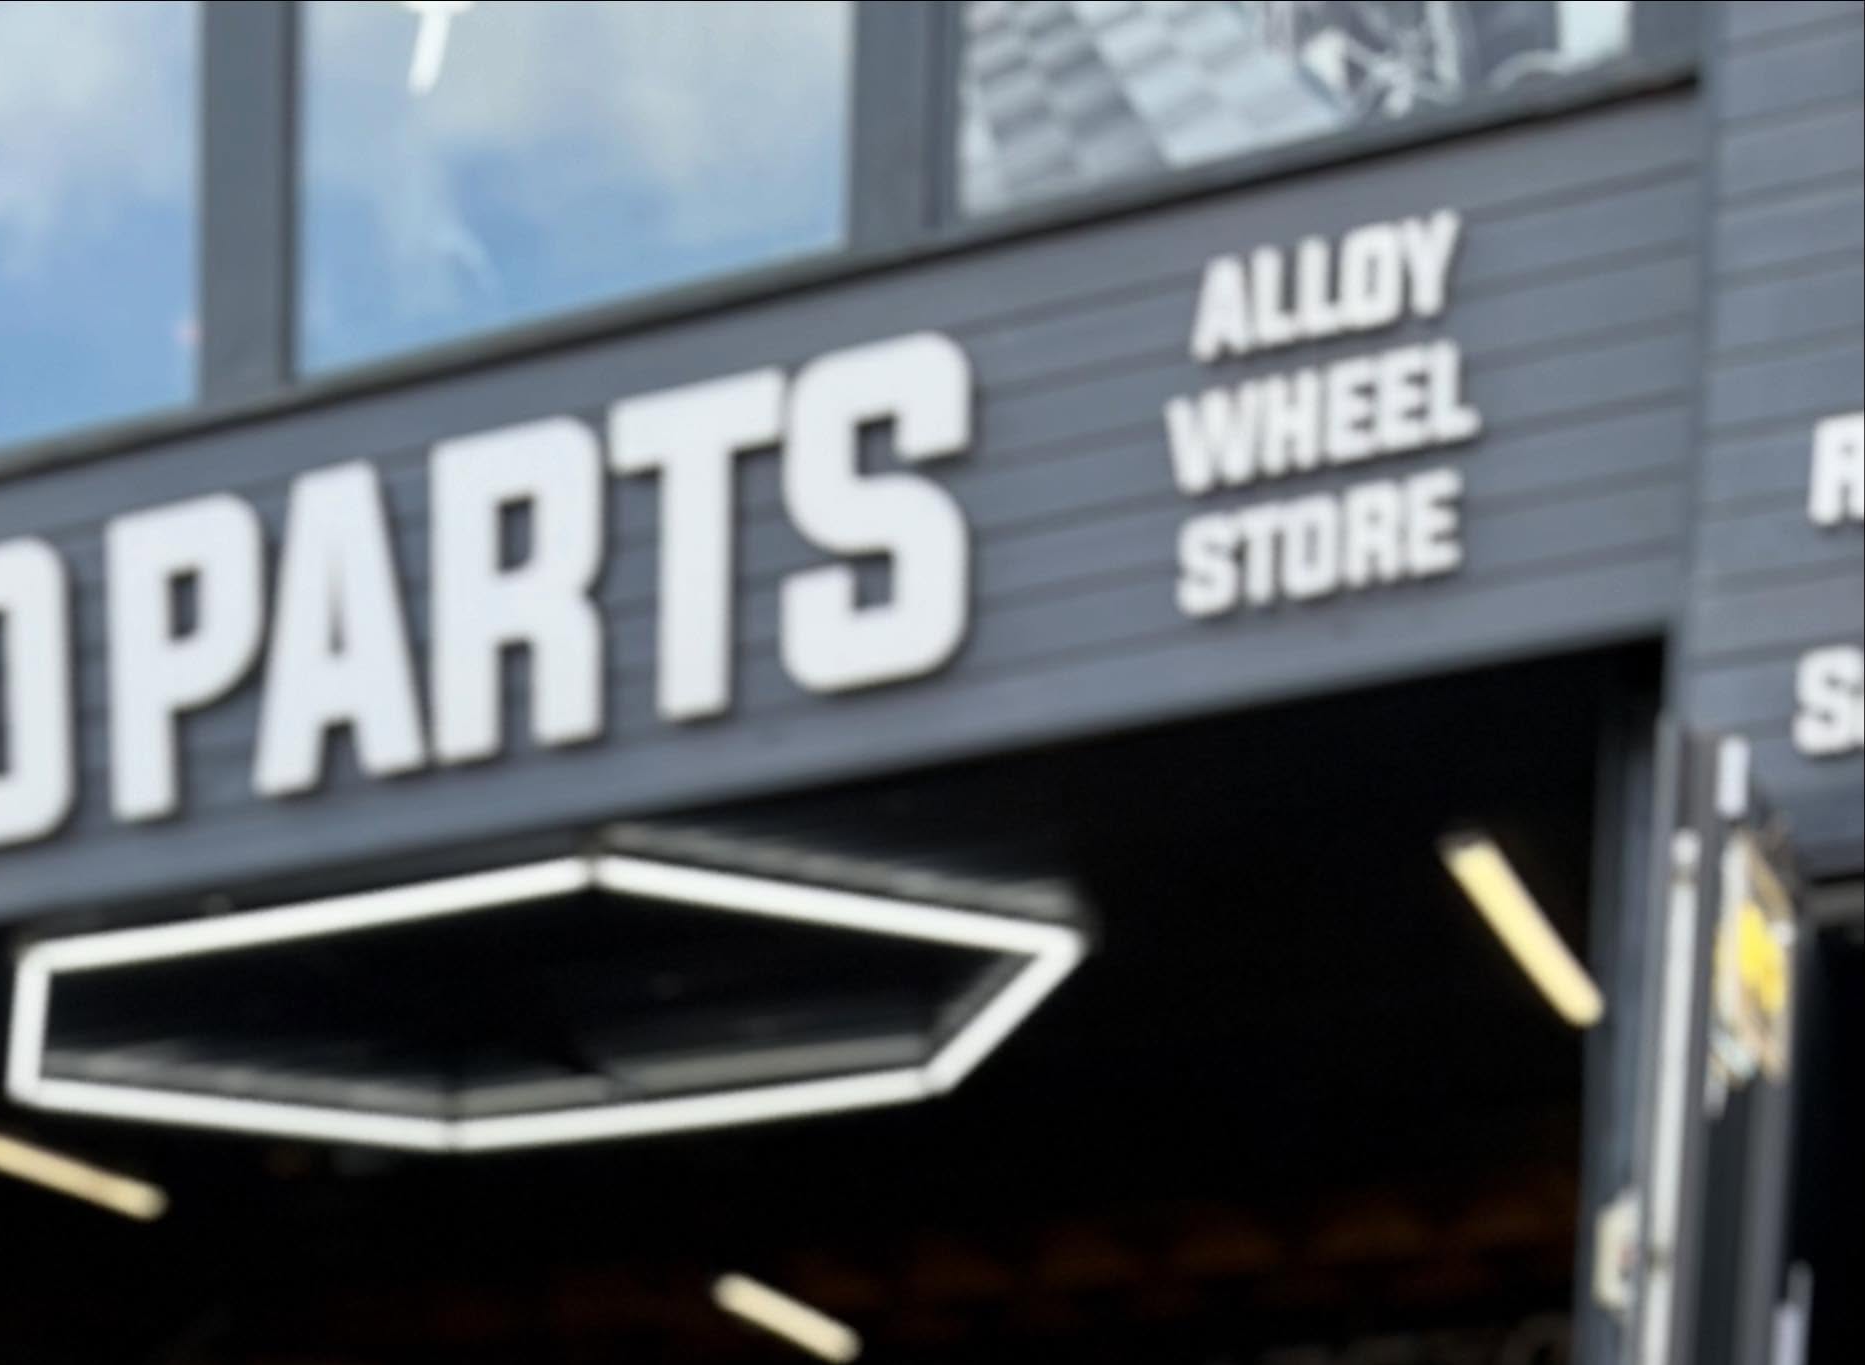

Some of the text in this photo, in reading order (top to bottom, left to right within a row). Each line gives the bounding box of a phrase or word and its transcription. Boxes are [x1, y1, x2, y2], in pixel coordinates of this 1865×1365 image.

[1191, 209, 1462, 364] ALLOY
[1164, 339, 1482, 495] WHEEL
[1175, 466, 1465, 617] STORE
